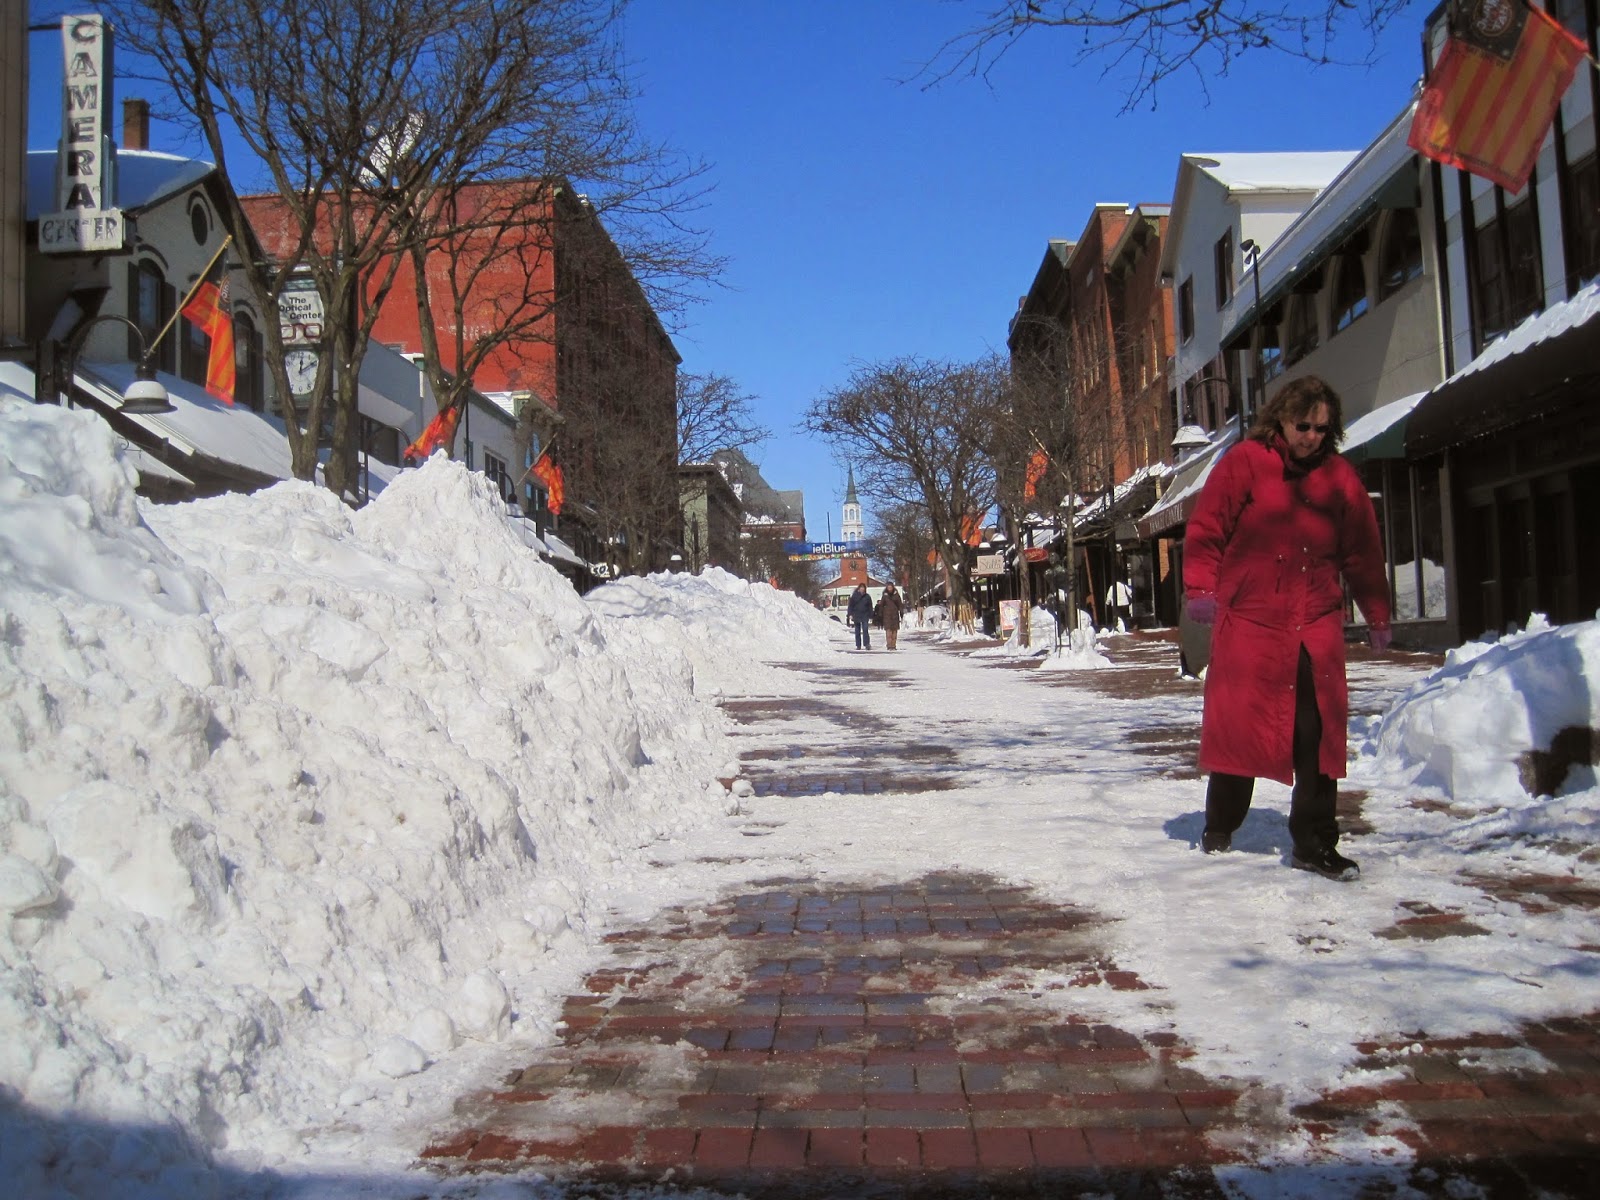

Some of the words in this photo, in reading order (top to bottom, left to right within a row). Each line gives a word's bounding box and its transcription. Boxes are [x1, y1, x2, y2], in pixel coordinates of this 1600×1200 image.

[67, 20, 98, 210] CAMERA
[279, 303, 312, 312] Optical
[290, 312, 321, 320] Center
